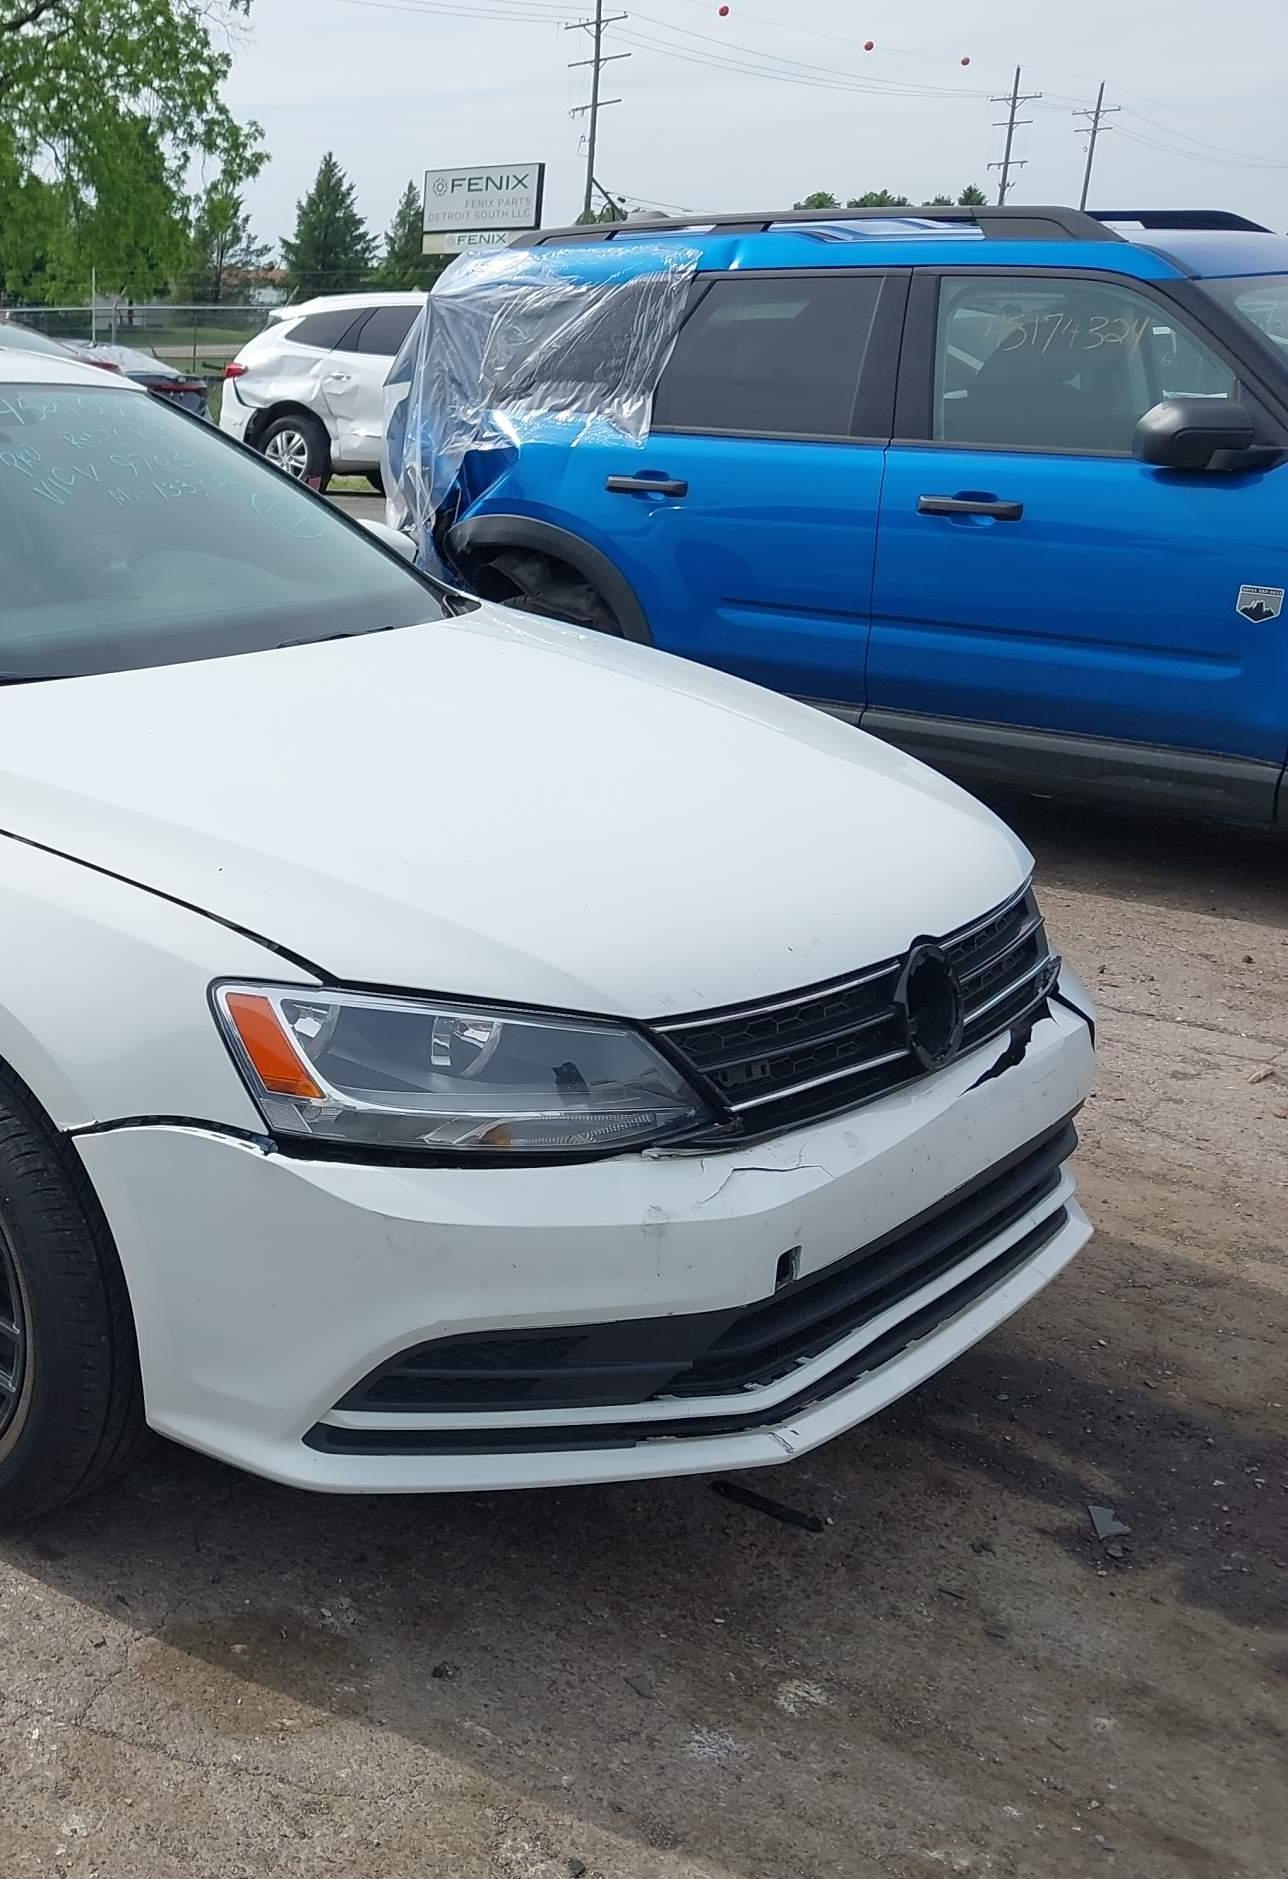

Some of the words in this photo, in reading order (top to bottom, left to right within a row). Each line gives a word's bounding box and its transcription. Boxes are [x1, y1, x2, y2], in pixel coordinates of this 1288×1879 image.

[450, 173, 530, 194] FENIX
[464, 198, 495, 209] FENIX
[497, 196, 532, 207] PARTS
[428, 211, 470, 223] DETROIT
[474, 209, 508, 220] SOUTH
[511, 208, 530, 218] LLC
[457, 232, 507, 246] FENIX
